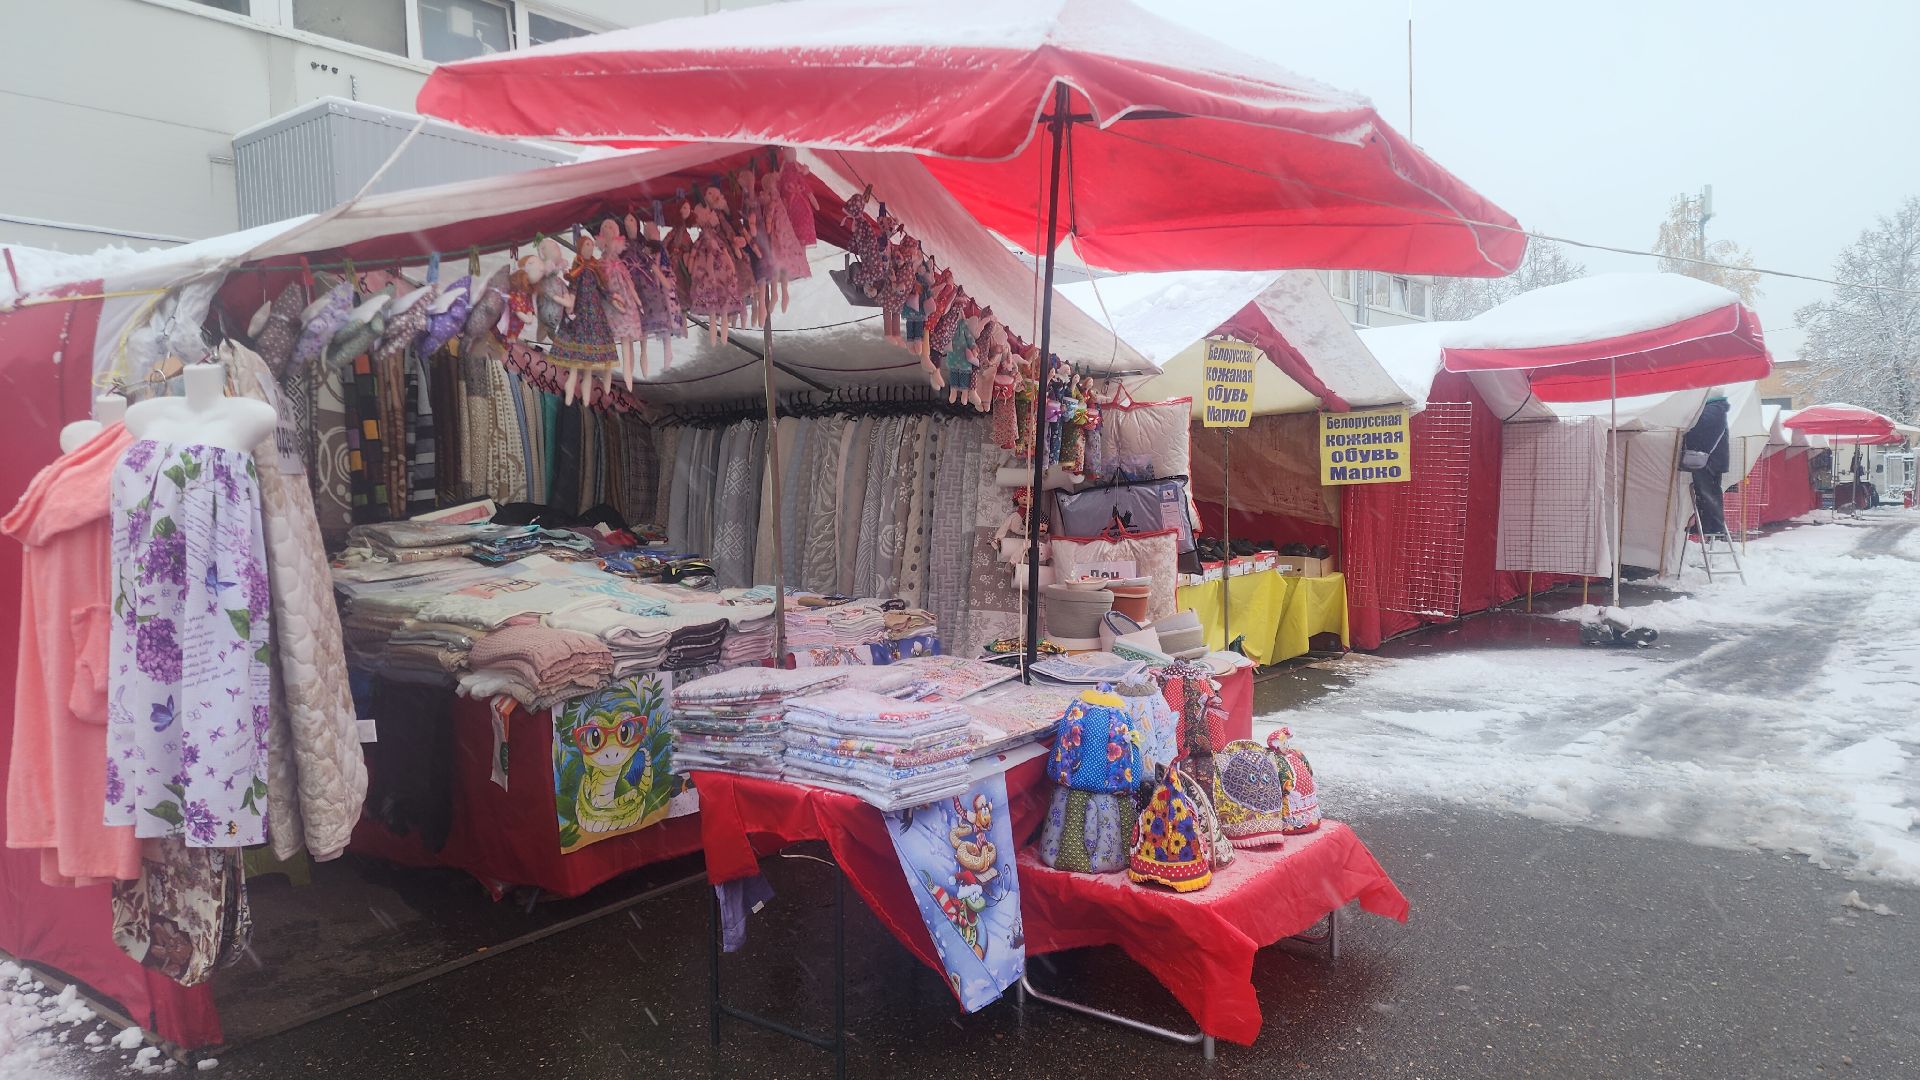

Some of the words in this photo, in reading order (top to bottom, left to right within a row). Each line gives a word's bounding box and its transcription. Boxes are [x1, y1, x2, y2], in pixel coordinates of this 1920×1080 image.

[1206, 367, 1253, 383] кожаная
[1207, 384, 1248, 403] обувь
[1207, 405, 1247, 423] Марко
[1326, 414, 1402, 430] Белорусская
[1325, 431, 1404, 447] кожаная
[1331, 447, 1399, 463] обувь
[1330, 465, 1402, 480] Марко
